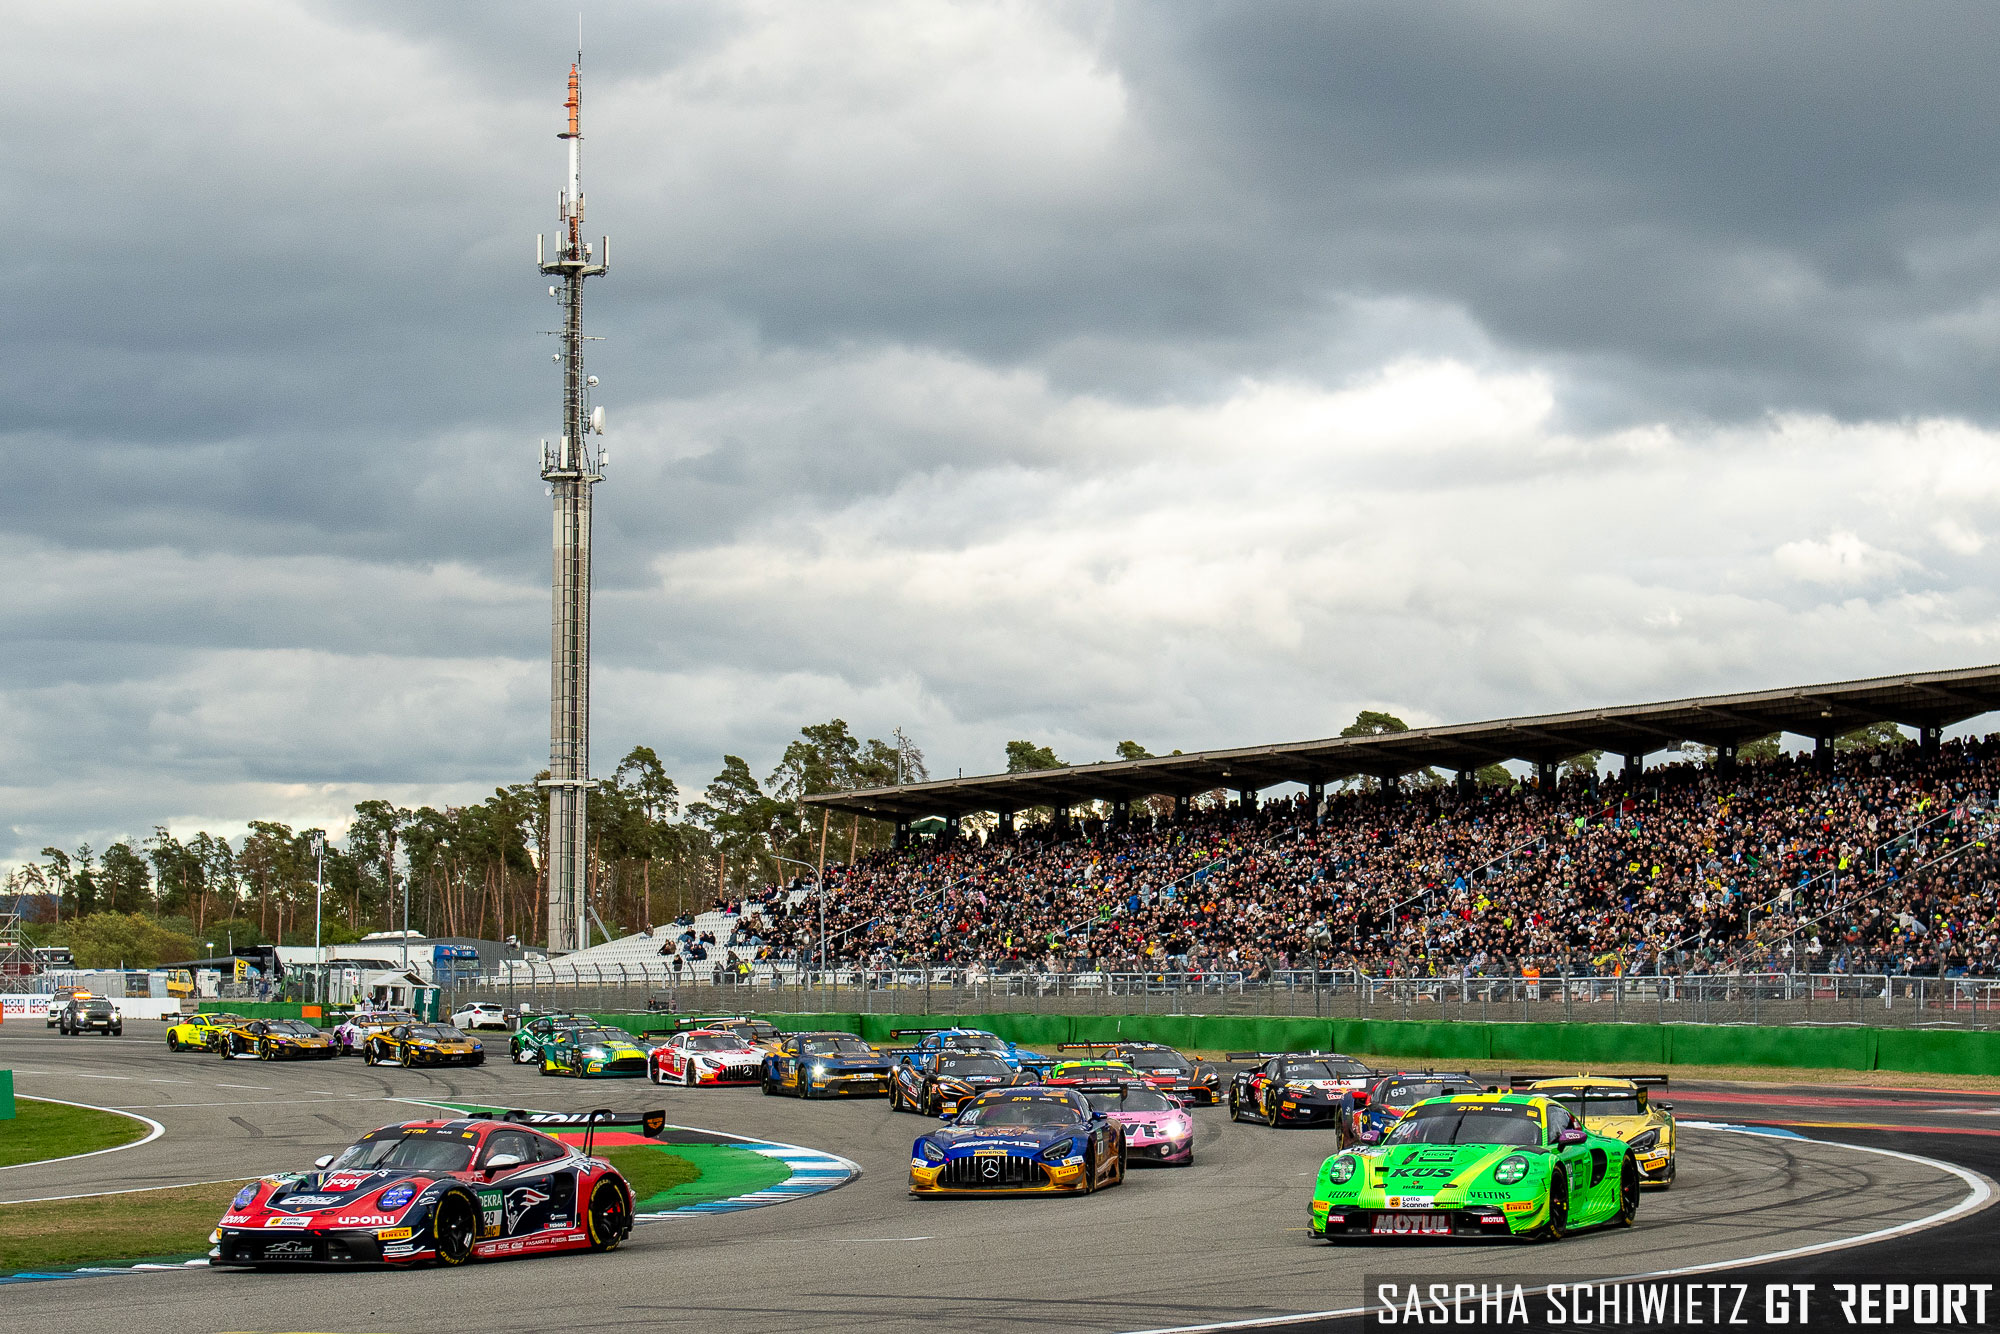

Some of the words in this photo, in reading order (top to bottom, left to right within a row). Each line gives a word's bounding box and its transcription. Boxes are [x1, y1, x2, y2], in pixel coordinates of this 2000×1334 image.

[944, 1060, 956, 1068] 16
[1391, 1088, 1407, 1097] 69
[1645, 1159, 1665, 1169] PIRELLI
[1058, 1166, 1078, 1176] PIRELLI
[1470, 1191, 1511, 1199] VELTINS
[1506, 1203, 1532, 1211] PIRELLI
[485, 1212, 495, 1225] 29
[1375, 1215, 1449, 1233] MOTUL
[381, 1229, 410, 1237] PIRELLI
